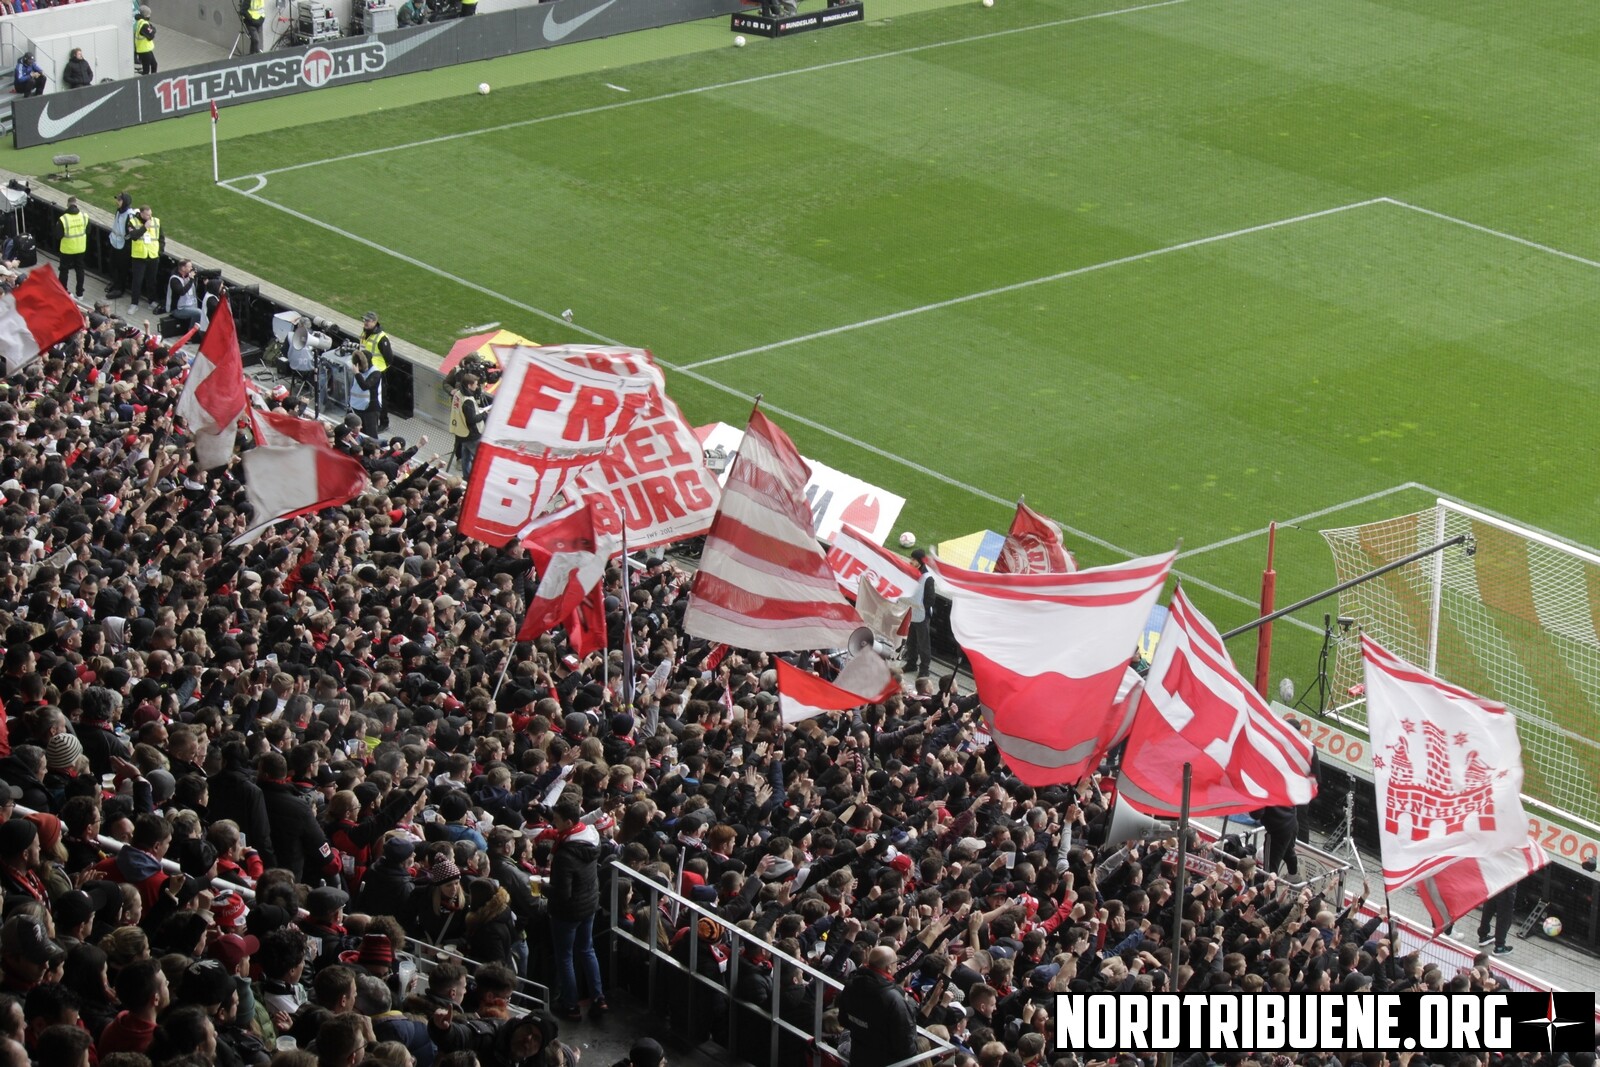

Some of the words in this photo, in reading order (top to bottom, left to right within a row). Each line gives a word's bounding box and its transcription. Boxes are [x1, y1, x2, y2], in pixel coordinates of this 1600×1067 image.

[785, 18, 817, 30] BUNDESLIGA
[822, 10, 859, 23] BUNDESLIGA.COM
[584, 469, 714, 536] BURG
[1386, 796, 1495, 818] SYNTHESIA
